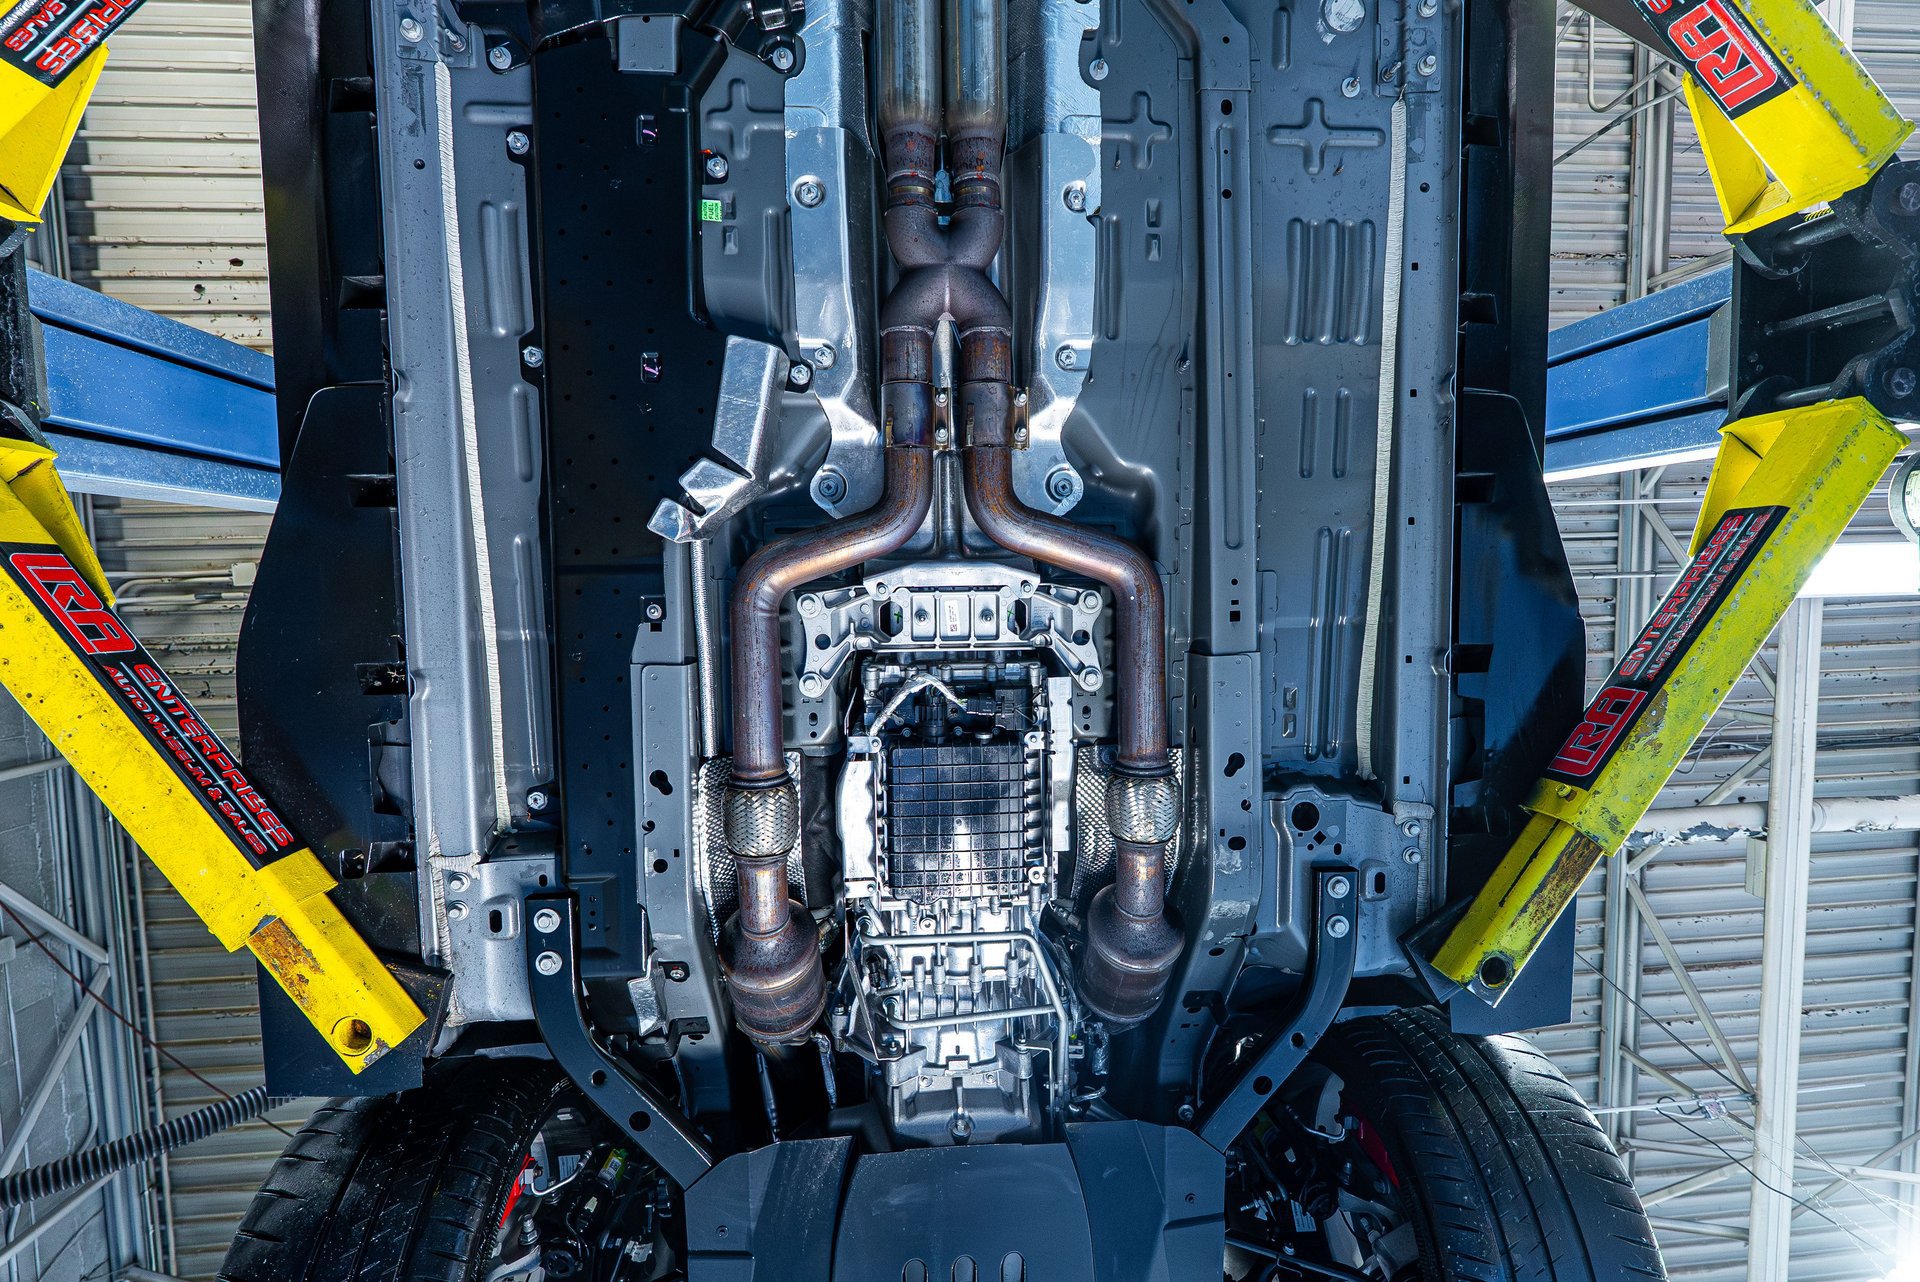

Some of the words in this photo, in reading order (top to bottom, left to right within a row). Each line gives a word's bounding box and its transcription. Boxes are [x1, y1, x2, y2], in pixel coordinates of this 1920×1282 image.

[4, 0, 67, 51] SALES
[1620, 515, 1744, 676] ENTERPRISES
[1647, 640, 1681, 681] AUTO
[1728, 513, 1770, 561] SALES
[101, 665, 152, 712] AUTO
[144, 713, 212, 786] MUSEUM
[207, 787, 222, 801] &
[218, 800, 267, 854] SALES
[134, 664, 294, 847] ENTERPRISES
